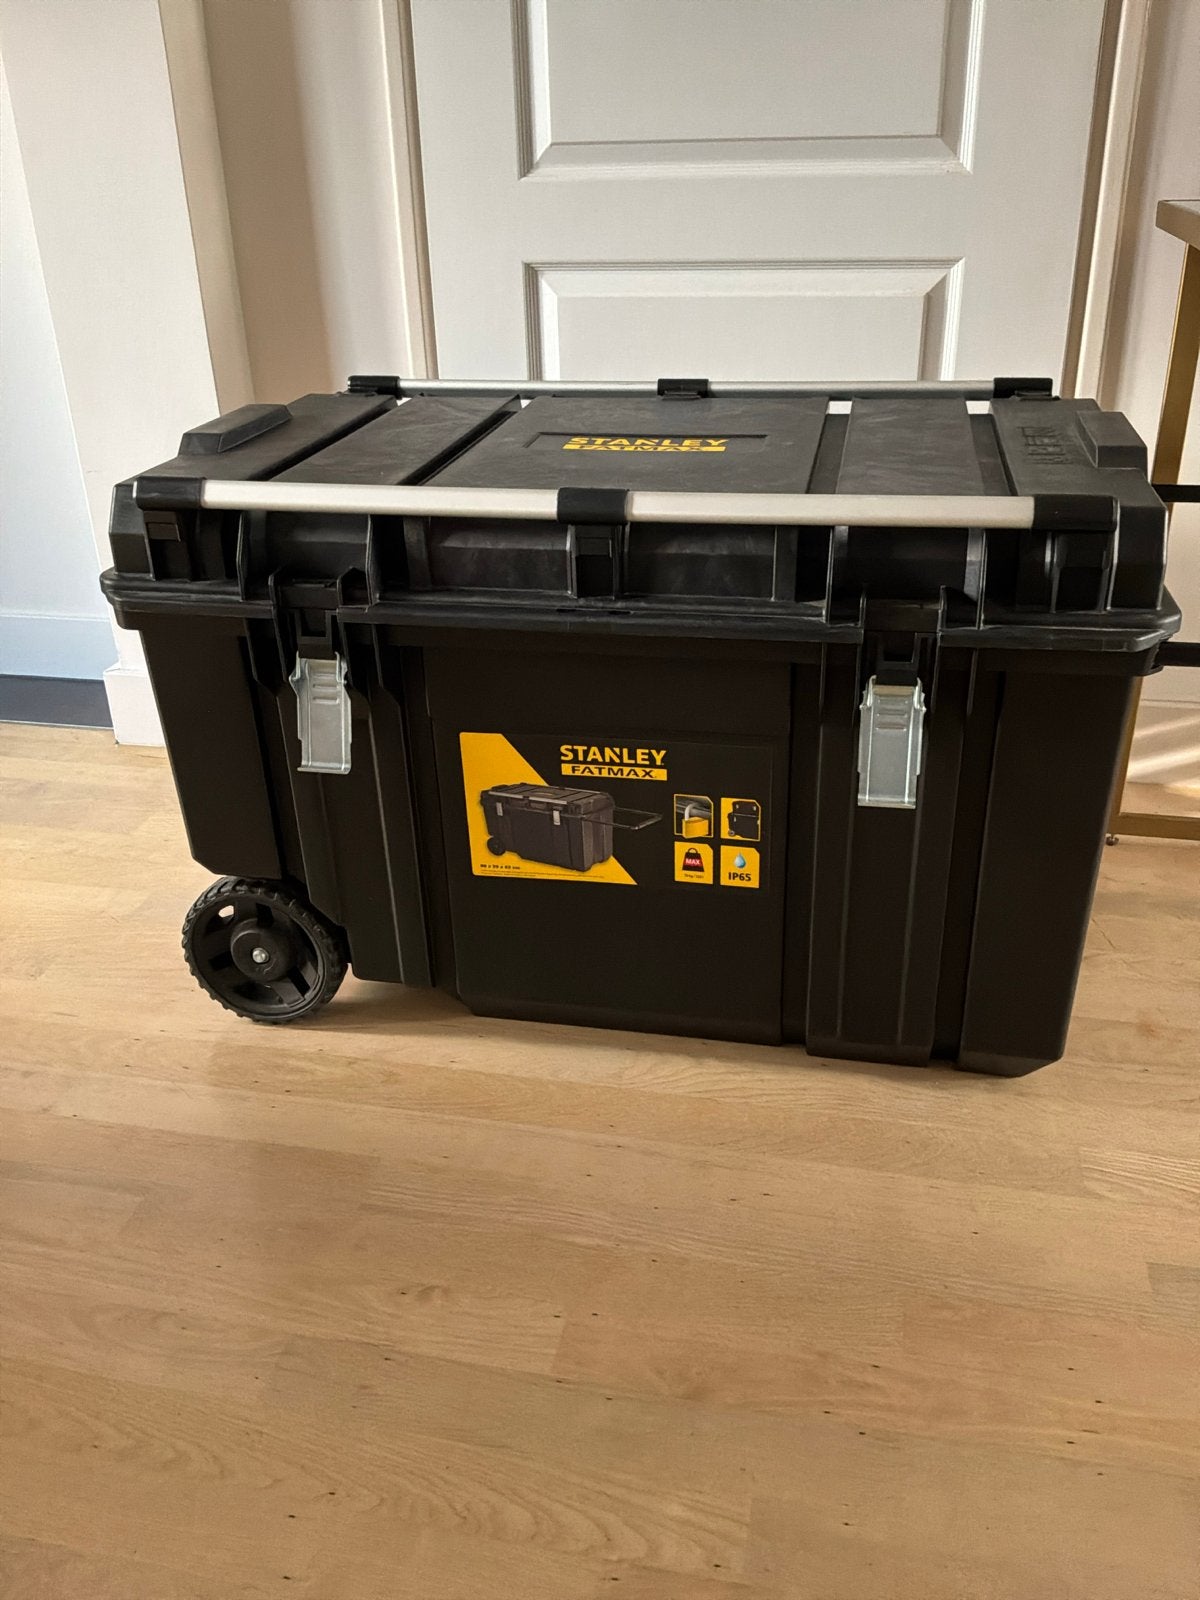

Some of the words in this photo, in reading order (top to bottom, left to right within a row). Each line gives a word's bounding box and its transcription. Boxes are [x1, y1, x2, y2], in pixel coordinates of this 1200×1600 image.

[568, 437, 729, 446] STANLEY
[560, 744, 667, 766] STANLEY
[571, 765, 654, 779] FATMAX
[685, 857, 701, 866] MAX
[728, 871, 752, 882] IP65
